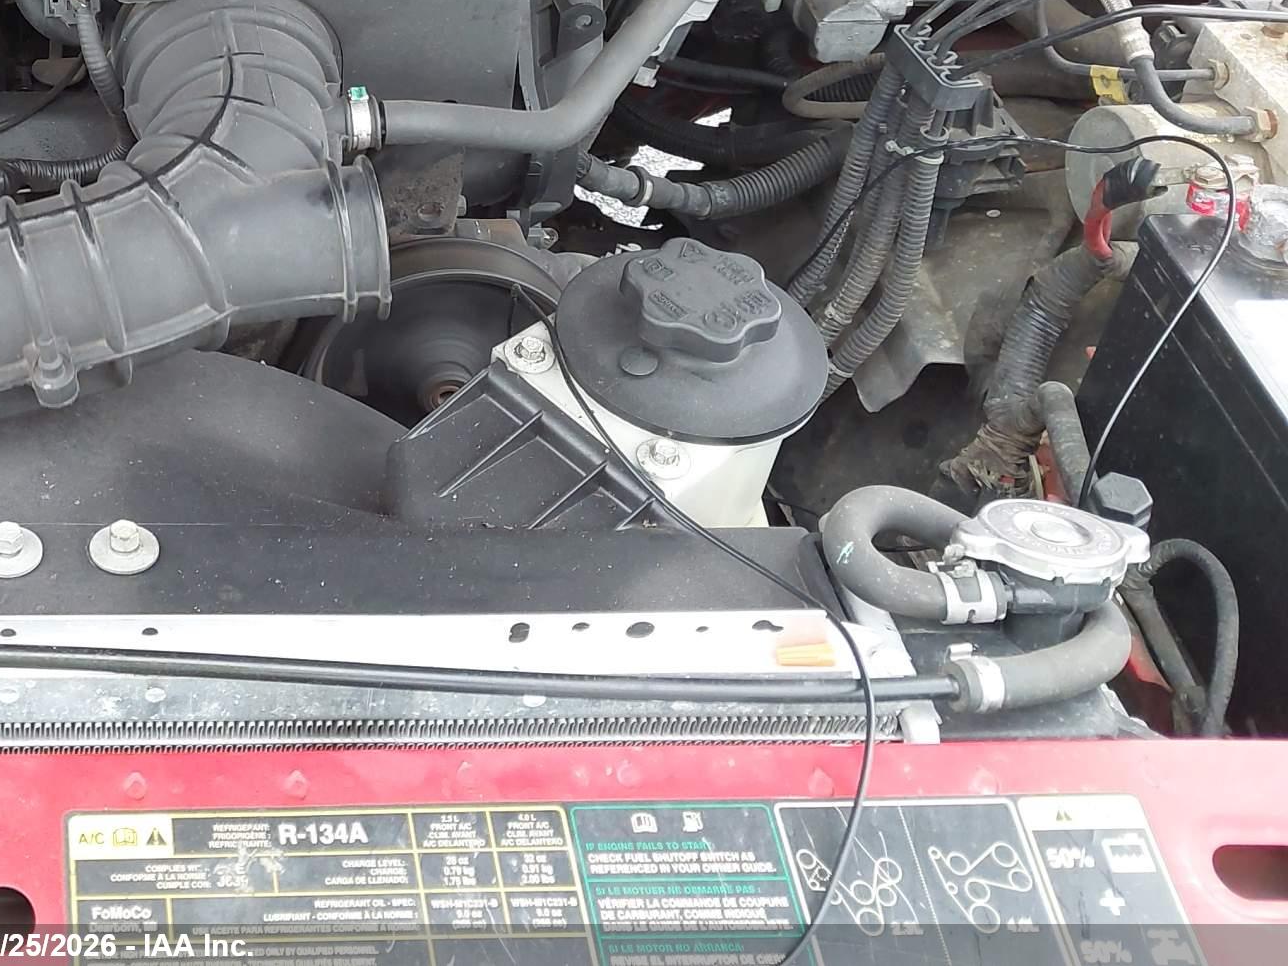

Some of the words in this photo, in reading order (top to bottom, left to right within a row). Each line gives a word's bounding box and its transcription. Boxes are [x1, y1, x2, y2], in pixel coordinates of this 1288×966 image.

[430, 823, 458, 831] FRONT
[507, 822, 534, 830] FRONT
[78, 831, 105, 845] A/C
[277, 821, 369, 845] R-134A
[597, 841, 634, 851] ENGINE
[636, 841, 664, 851] FAILS
[665, 841, 679, 850] TO
[587, 852, 624, 863] CHECK
[624, 852, 652, 863] FUEL
[652, 851, 698, 863] SHUTOFF
[699, 851, 740, 862] SWITCH
[740, 851, 756, 862] AS
[1046, 846, 1096, 869] 50%
[589, 863, 658, 874] REFERENCED
[658, 863, 671, 874] IN
[671, 862, 701, 874] YOUR
[701, 862, 741, 873] OWNER
[741, 862, 777, 873] GUIDE.
[165, 873, 176, 881] LA
[354, 876, 367, 884] DE
[313, 899, 370, 909] REFRIGERANT
[597, 896, 644, 909] VÉRIFIER
[644, 898, 660, 909] LA
[660, 898, 721, 909] COMMANDE
[721, 897, 737, 908] DE
[738, 896, 790, 908] COUPURE
[91, 905, 152, 920] FoMoCo
[371, 910, 382, 919] LA
[600, 909, 616, 921] DE
[683, 909, 723, 920] COMME
[675, 944, 691, 953] NO
[1079, 940, 1133, 963] 50%
